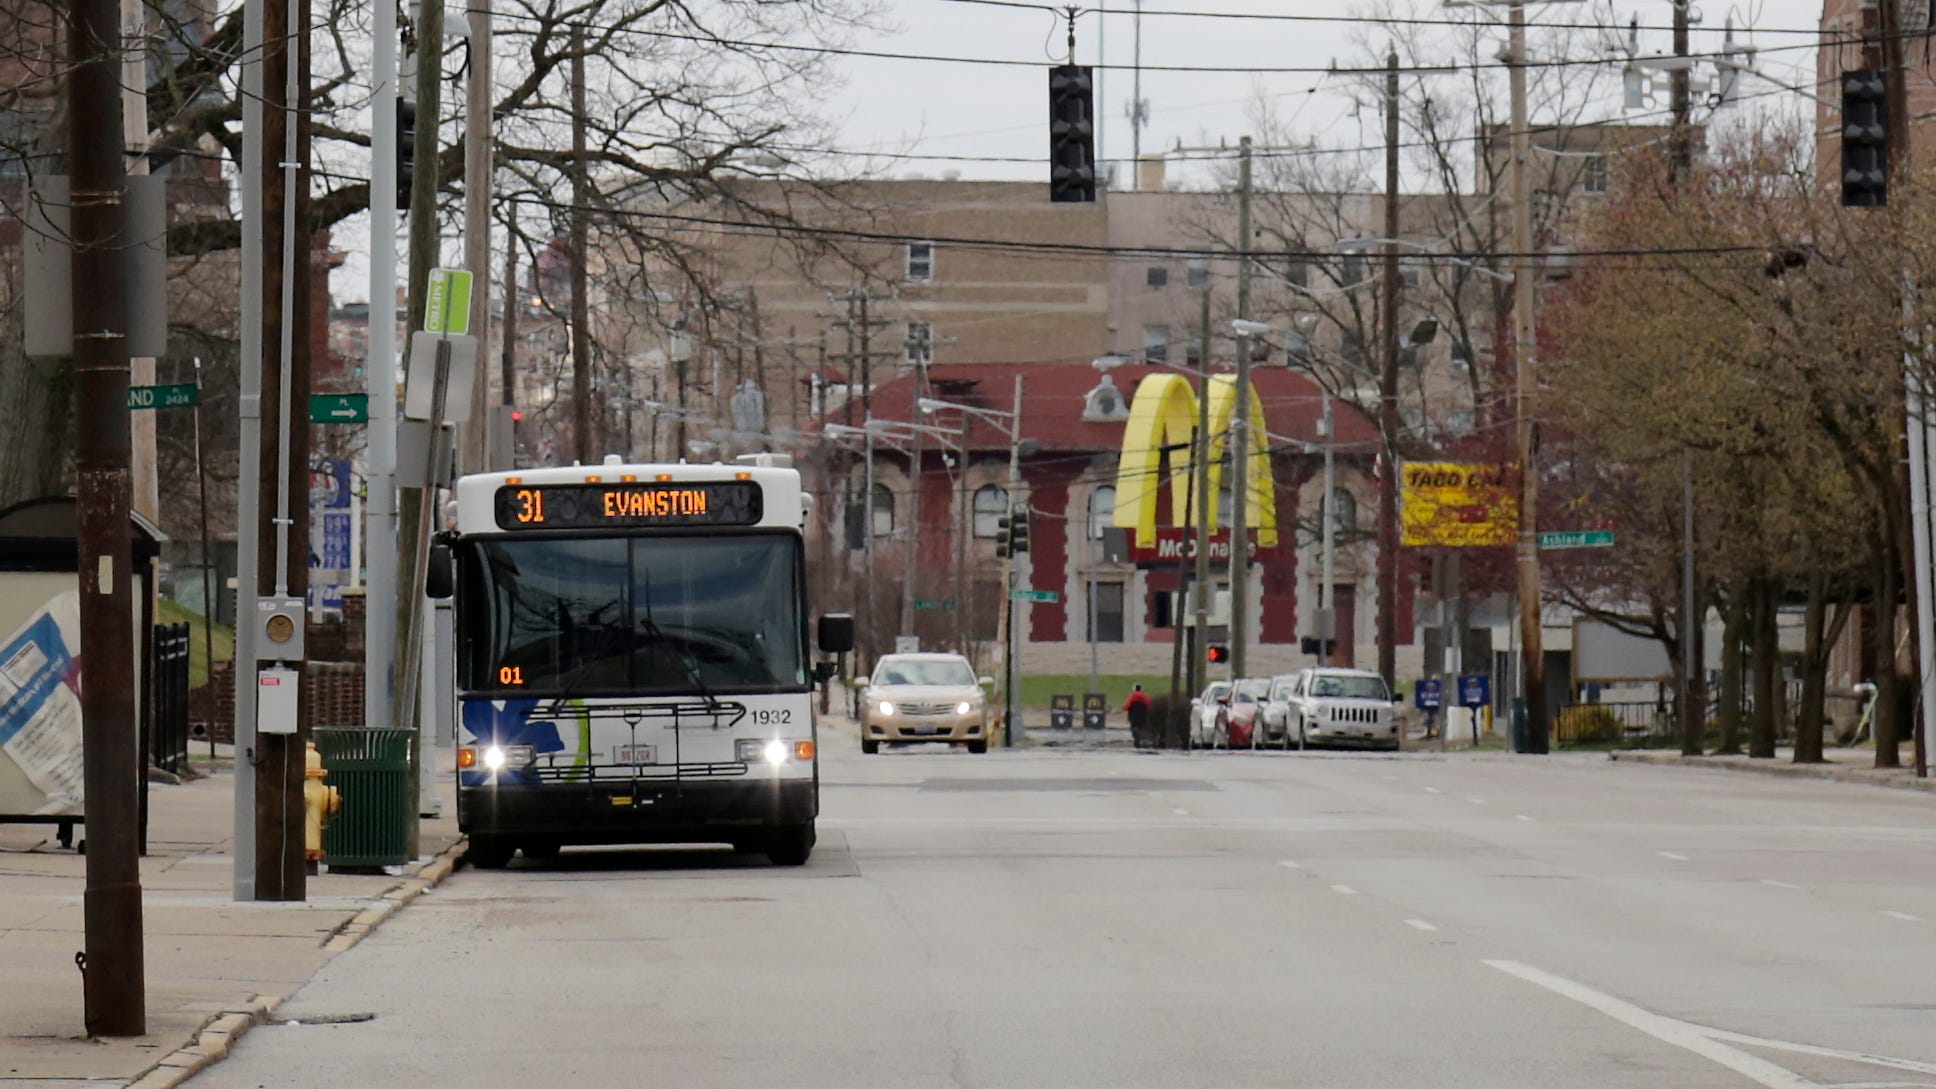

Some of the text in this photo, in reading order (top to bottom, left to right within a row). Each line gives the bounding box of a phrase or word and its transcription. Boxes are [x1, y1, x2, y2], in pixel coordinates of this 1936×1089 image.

[430, 284, 442, 331] METRO
[517, 490, 706, 522] 31 EVANSTON
[500, 666, 523, 684] 01
[752, 709, 791, 724] 1932
